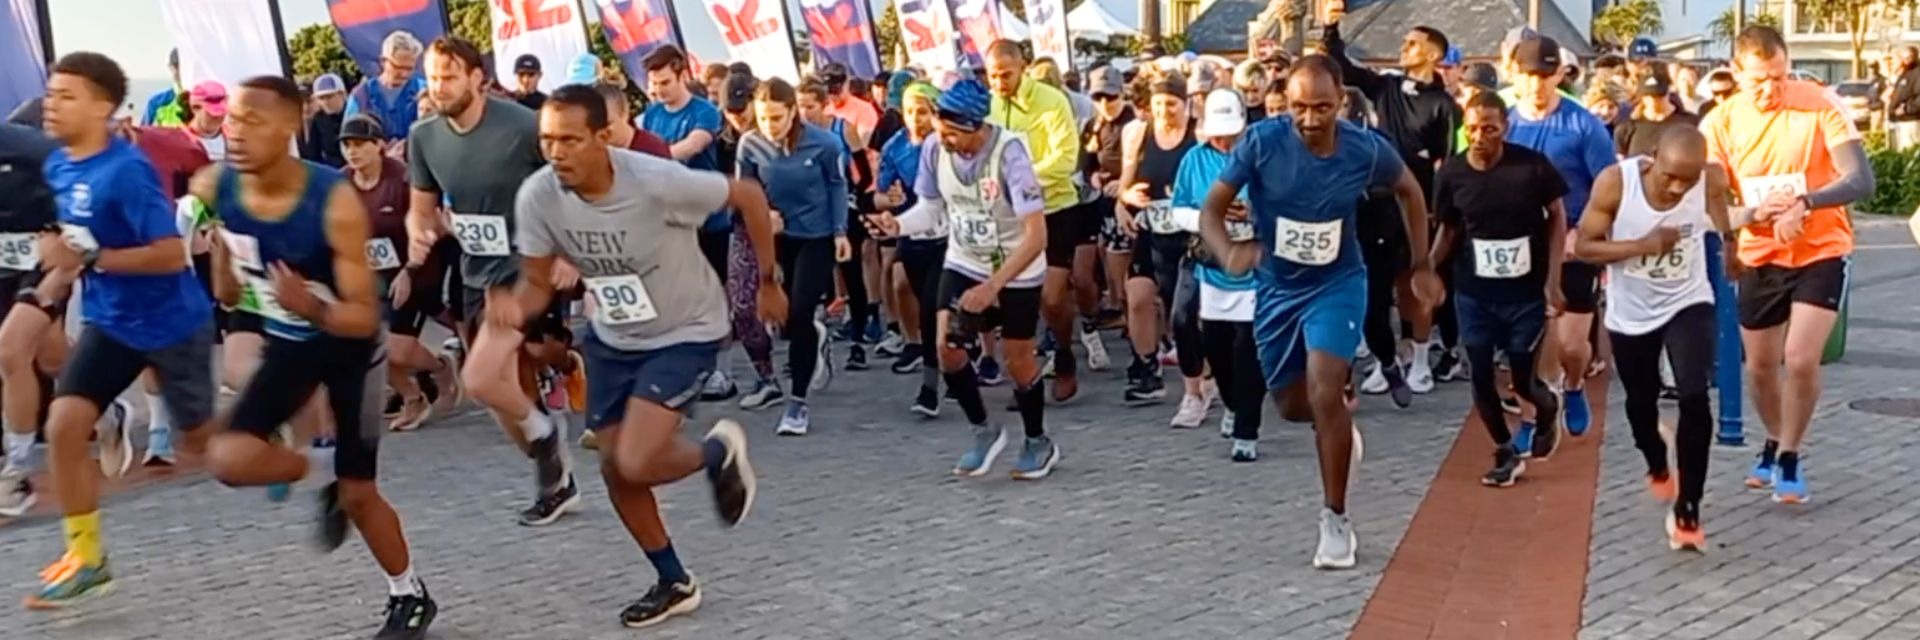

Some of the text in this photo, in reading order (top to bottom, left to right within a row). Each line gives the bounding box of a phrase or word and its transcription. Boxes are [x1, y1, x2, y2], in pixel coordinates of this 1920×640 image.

[456, 222, 497, 242] 230
[563, 229, 627, 254] NEW
[1285, 229, 1331, 251] 255
[0, 240, 31, 256] 46
[1482, 247, 1519, 265] 167
[576, 257, 638, 275] ORK
